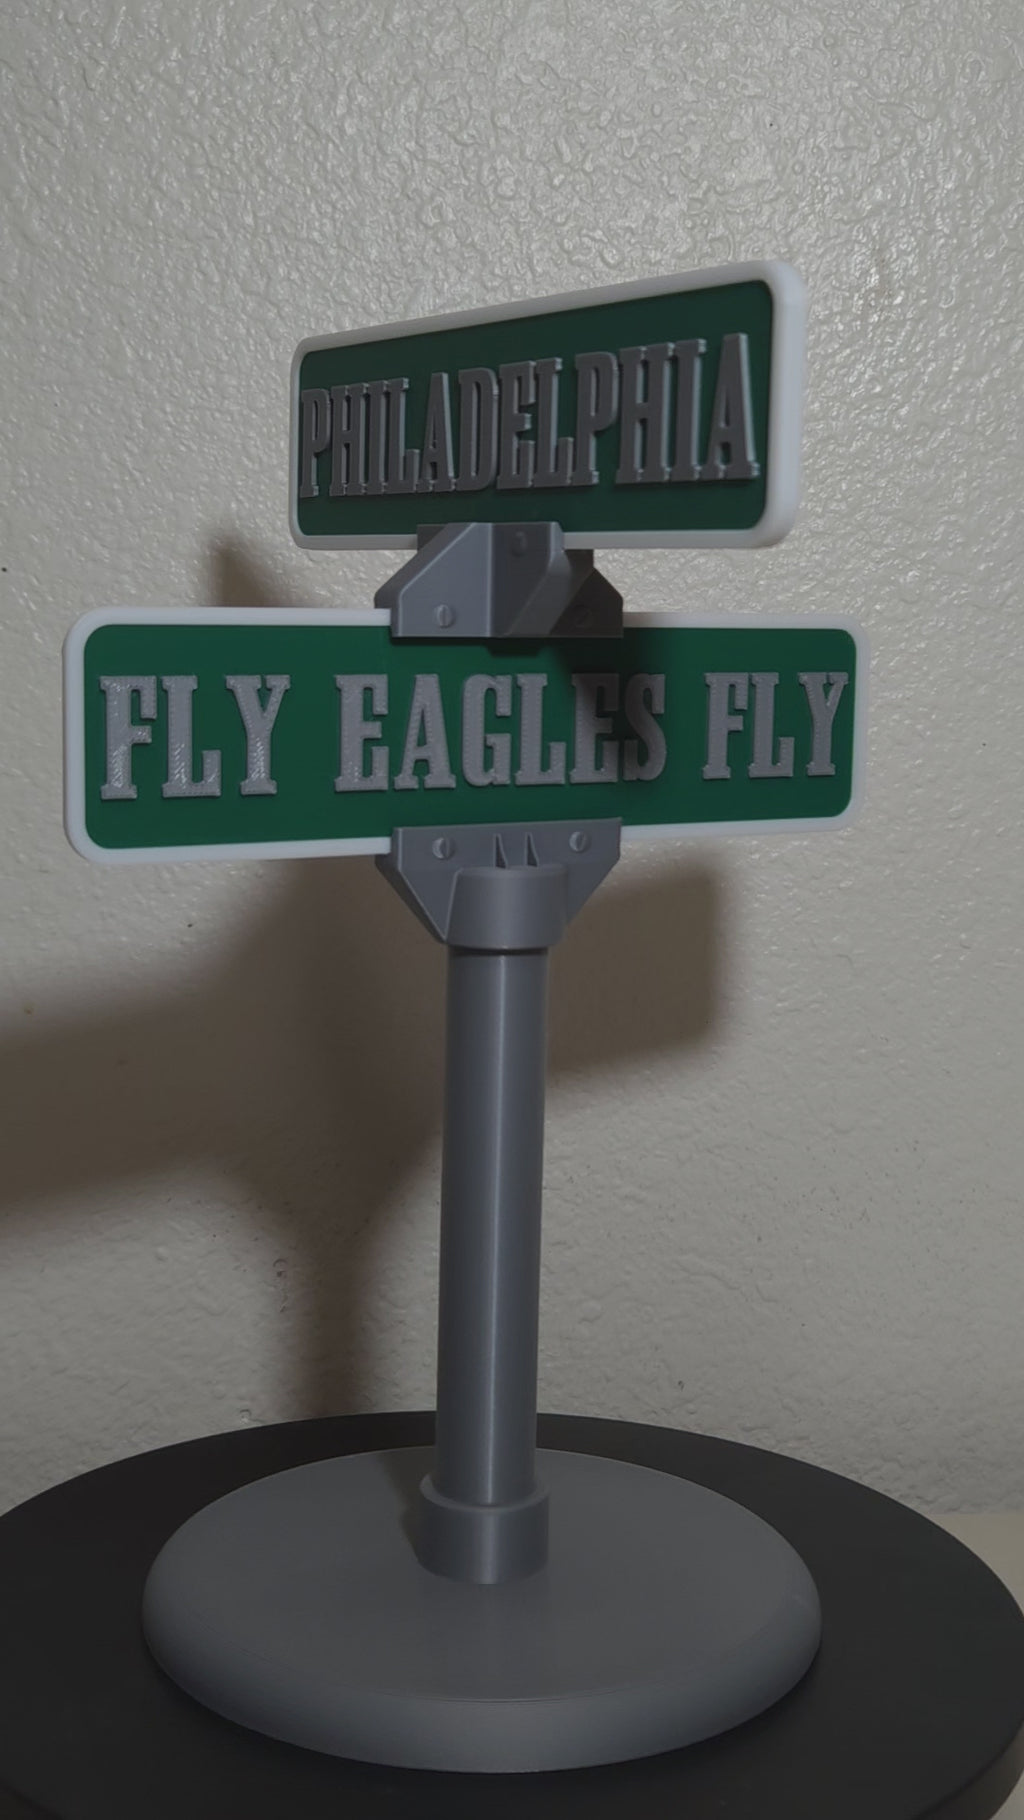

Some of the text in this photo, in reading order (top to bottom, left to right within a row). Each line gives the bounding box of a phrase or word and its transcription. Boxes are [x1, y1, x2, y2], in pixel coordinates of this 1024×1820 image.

[300, 332, 760, 498] PHILADELPHIA
[99, 671, 849, 800] FLY EAGLES FLY
